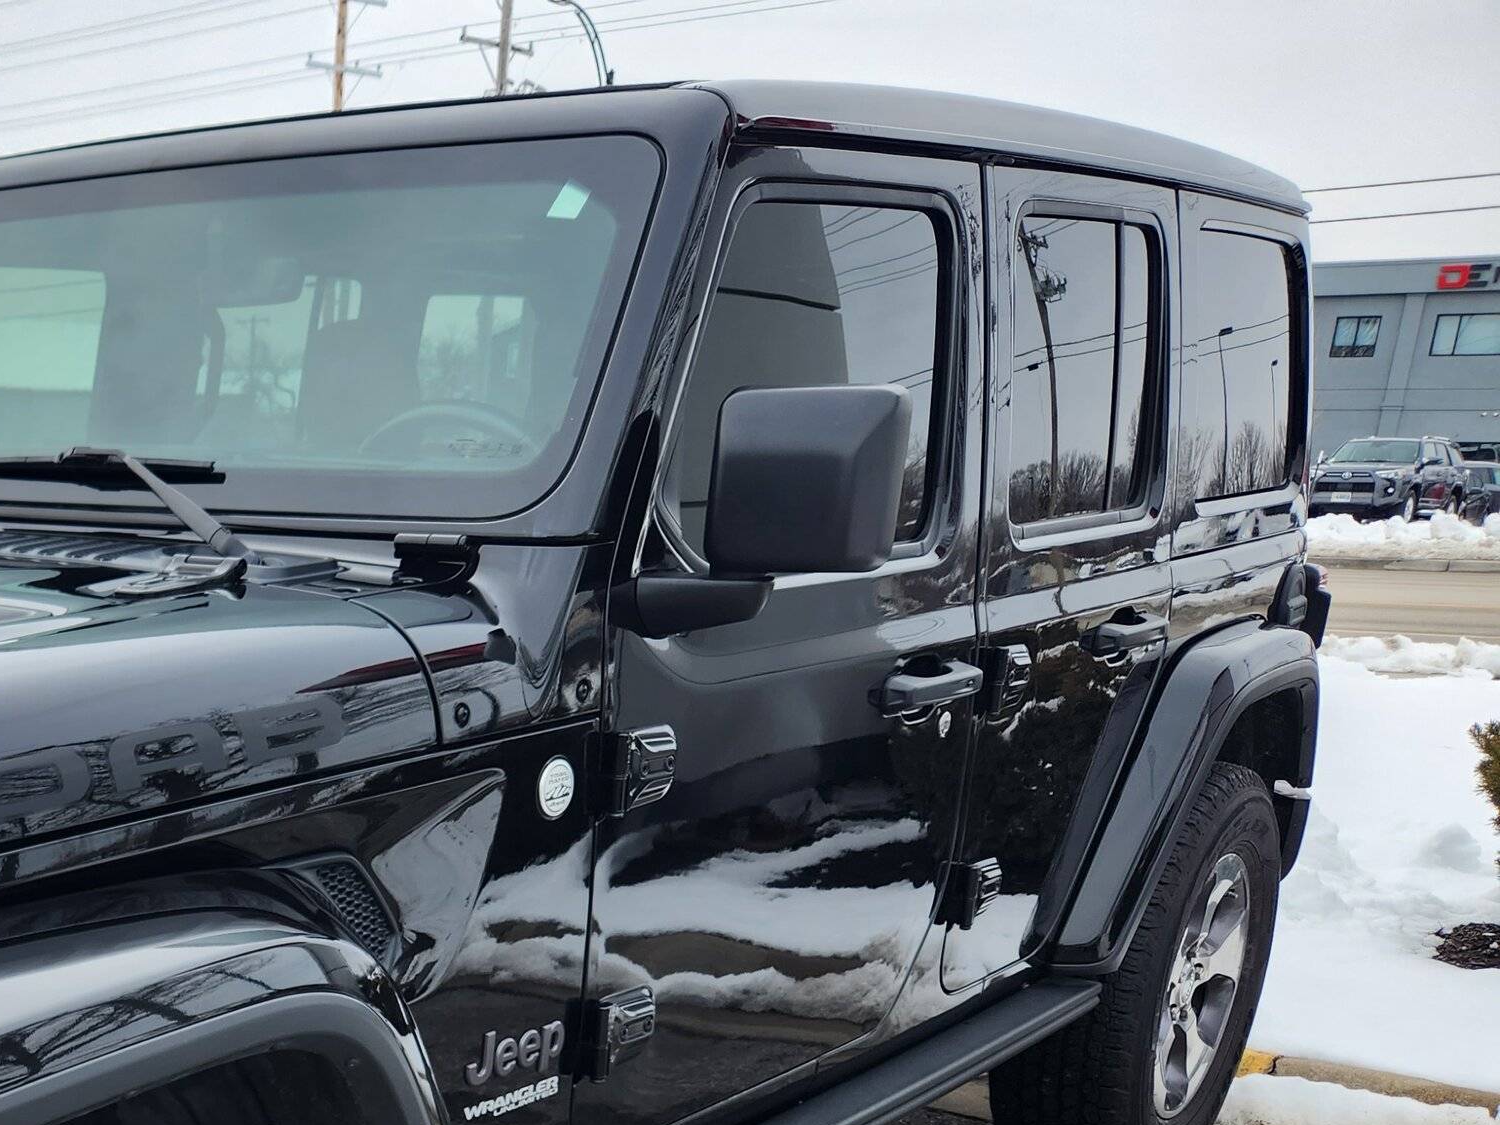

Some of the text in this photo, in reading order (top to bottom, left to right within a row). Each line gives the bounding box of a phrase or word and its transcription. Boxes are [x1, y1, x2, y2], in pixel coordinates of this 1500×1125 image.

[1436, 262, 1500, 290] DE
[466, 1020, 565, 1086] Jeep
[463, 1075, 560, 1121] WRANGLER
[493, 1087, 559, 1117] UNLIMITED
